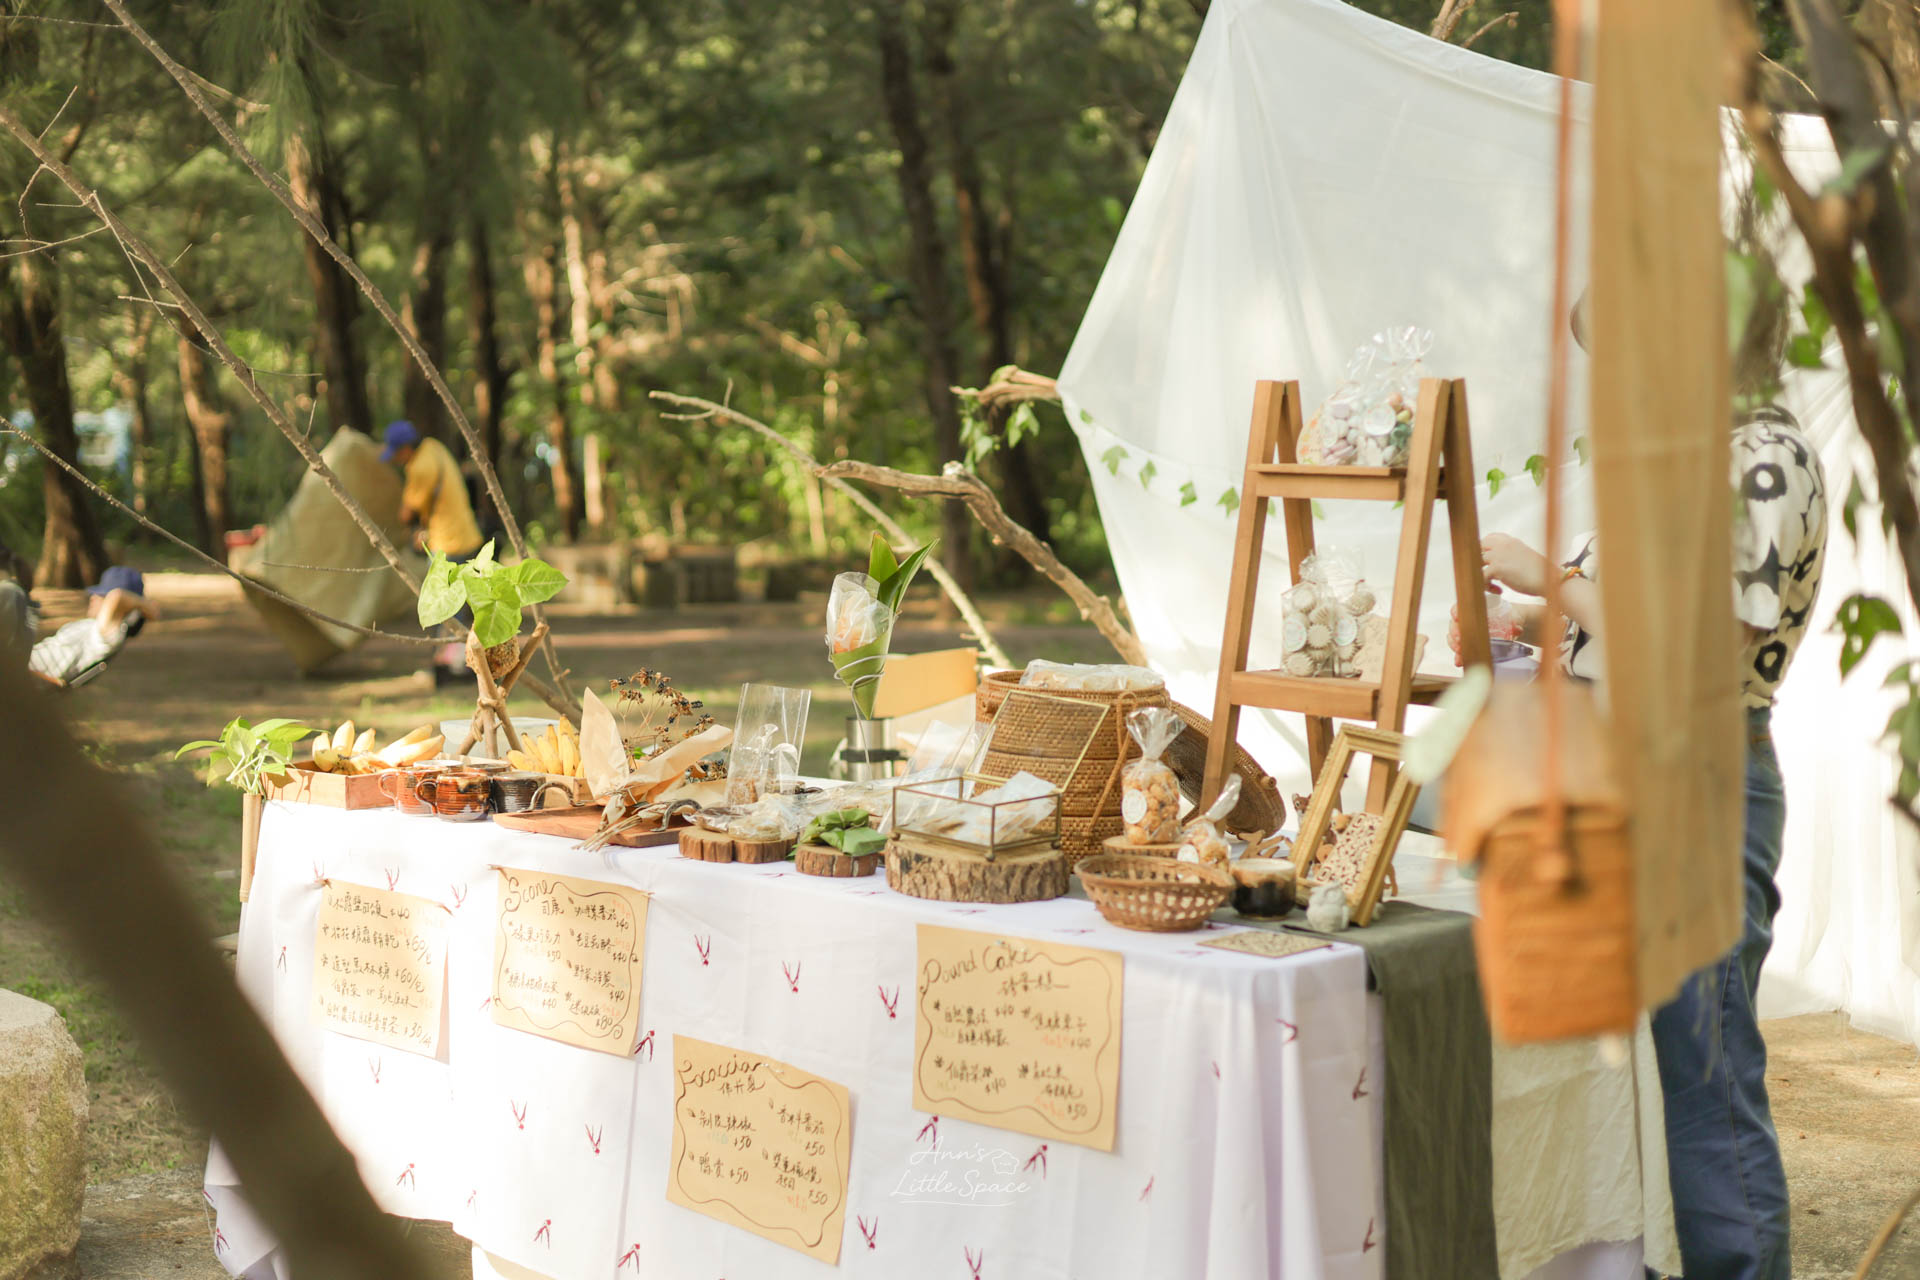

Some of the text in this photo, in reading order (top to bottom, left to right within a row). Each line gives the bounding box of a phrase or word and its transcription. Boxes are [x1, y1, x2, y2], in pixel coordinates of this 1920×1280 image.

[505, 876, 551, 913] Scone
[542, 897, 564, 916] 司康
[921, 941, 1032, 988] Pound Cake
[729, 1168, 749, 1184] $50
